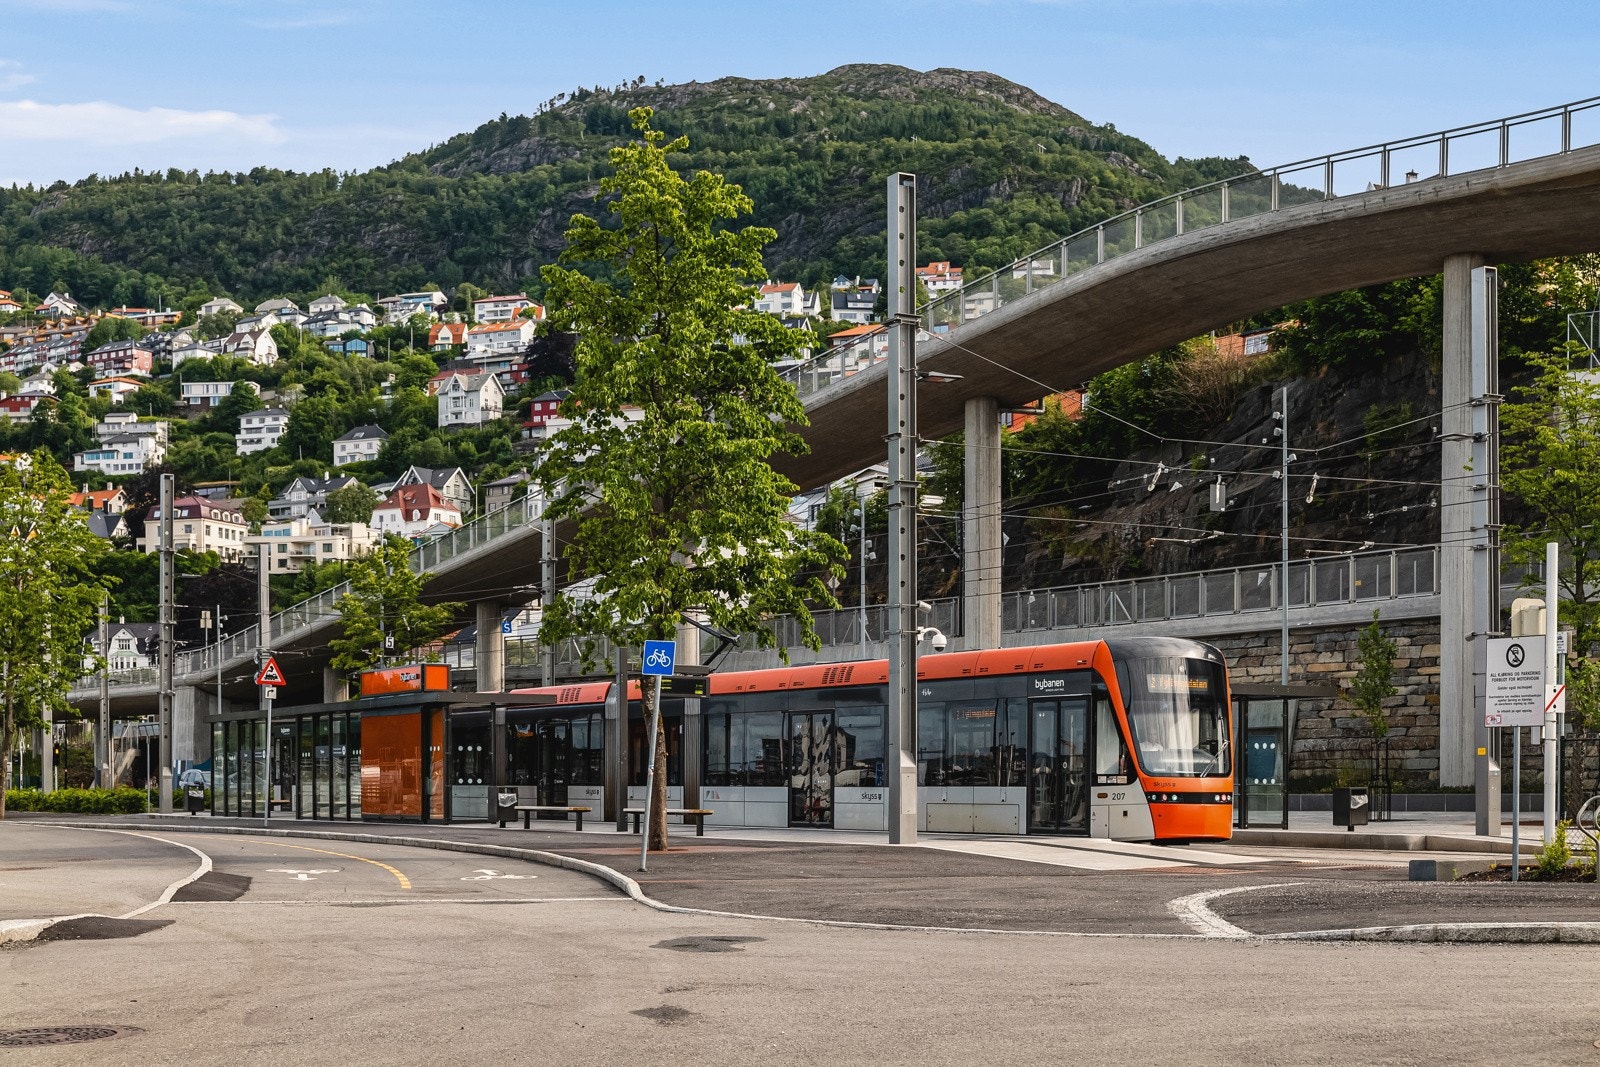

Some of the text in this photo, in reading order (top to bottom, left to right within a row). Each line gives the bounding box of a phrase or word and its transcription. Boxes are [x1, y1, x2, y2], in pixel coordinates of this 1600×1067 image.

[504, 623, 510, 632] S
[387, 637, 393, 648] 5
[1034, 678, 1064, 690] bybanen
[862, 792, 877, 801] skyss
[1112, 792, 1126, 800] 207
